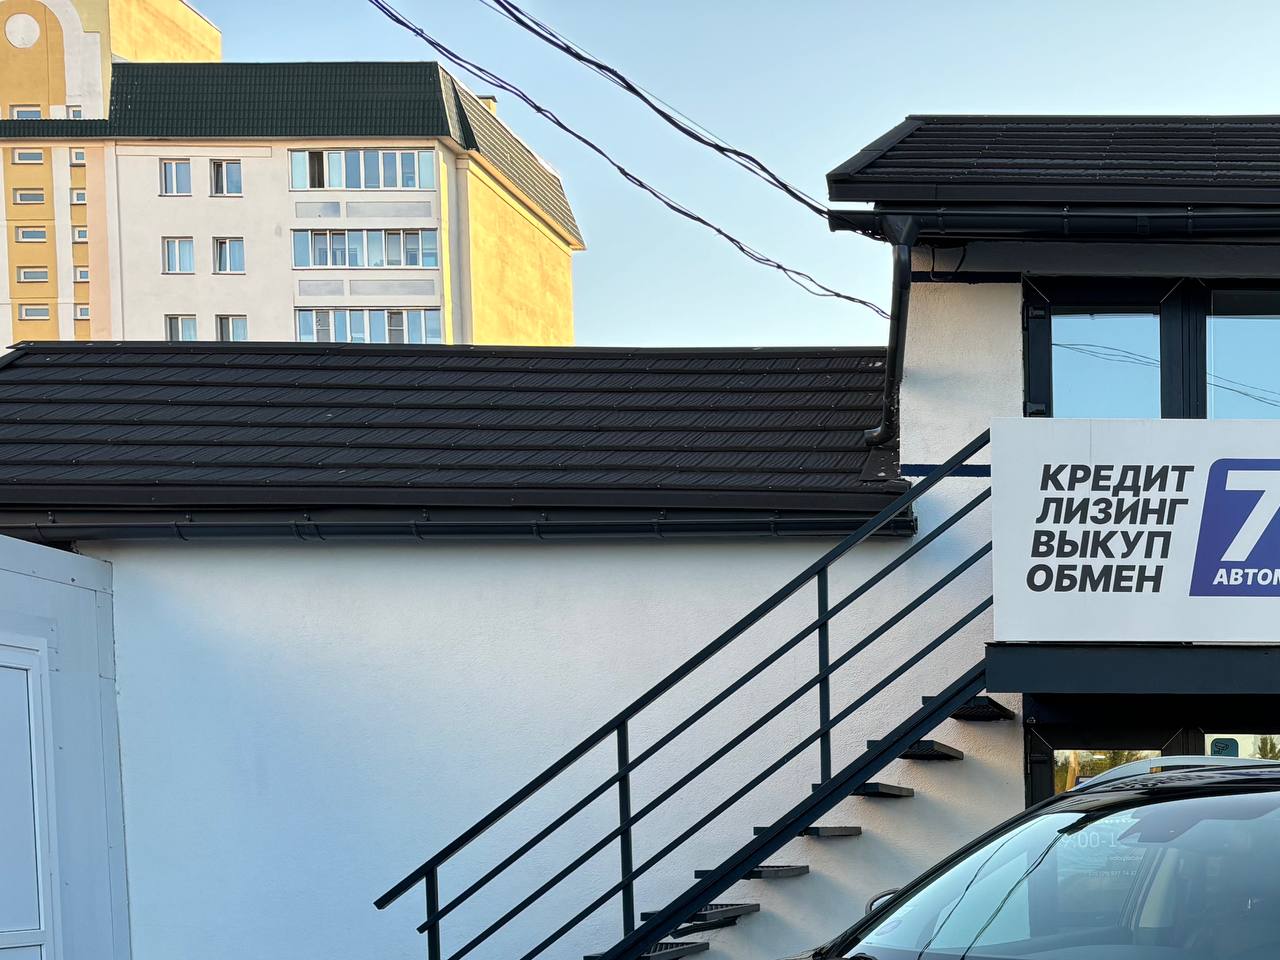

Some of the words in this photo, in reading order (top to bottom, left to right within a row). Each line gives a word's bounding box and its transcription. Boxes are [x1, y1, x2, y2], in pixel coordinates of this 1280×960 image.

[1040, 464, 1194, 494] КРЕДИТ
[1036, 497, 1188, 525] ЛИЗИНГ
[1030, 530, 1171, 558] ВЫКУП
[1026, 563, 1163, 592] ОБМЕН
